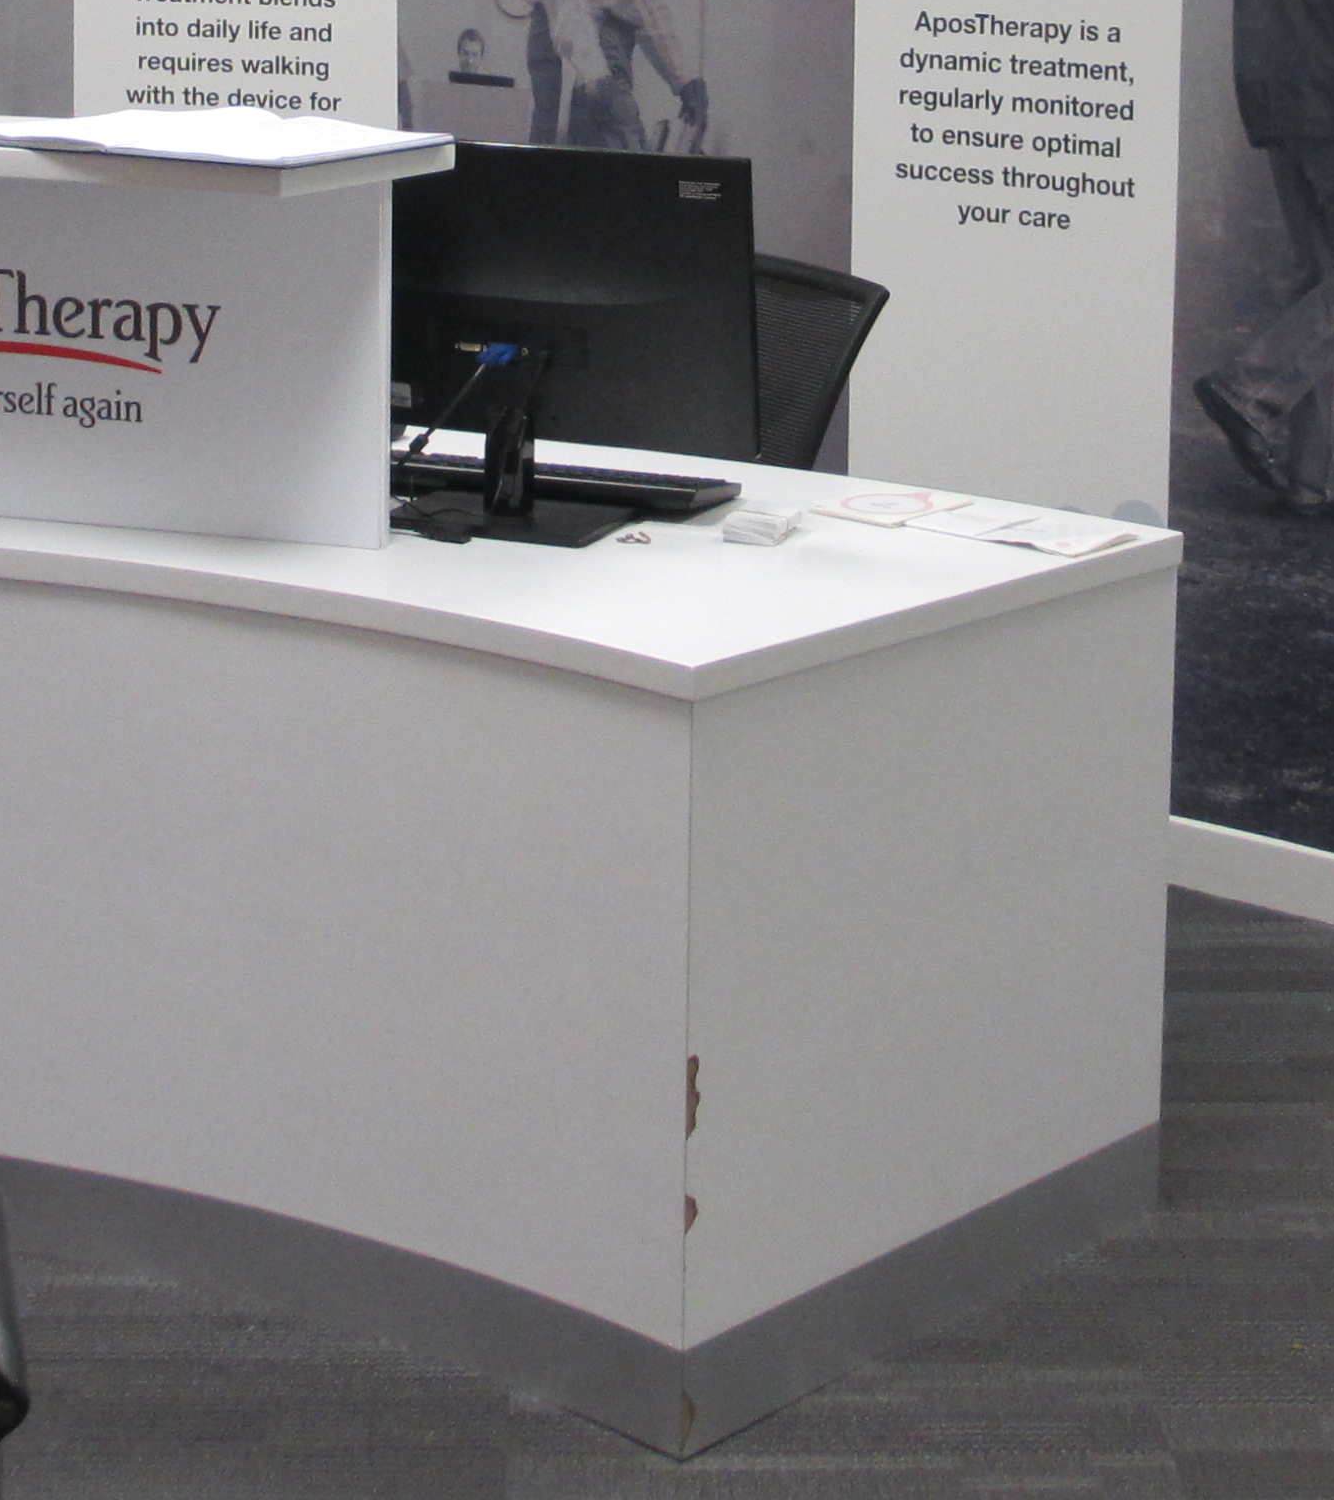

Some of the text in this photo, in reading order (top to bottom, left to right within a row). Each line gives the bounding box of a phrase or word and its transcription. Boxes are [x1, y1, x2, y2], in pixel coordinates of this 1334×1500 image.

[136, 19, 332, 43] into daily life and
[915, 11, 1120, 44] AposTherapy is a
[139, 56, 329, 81] requires walking
[900, 48, 1134, 85] dynamic treatment,
[126, 86, 341, 111] with the device for
[900, 88, 1134, 121] regularly monitored
[911, 124, 1120, 158] to ensure optimal
[896, 163, 1134, 198] success throughout
[958, 205, 1070, 230] your care
[63, 390, 142, 428] again
